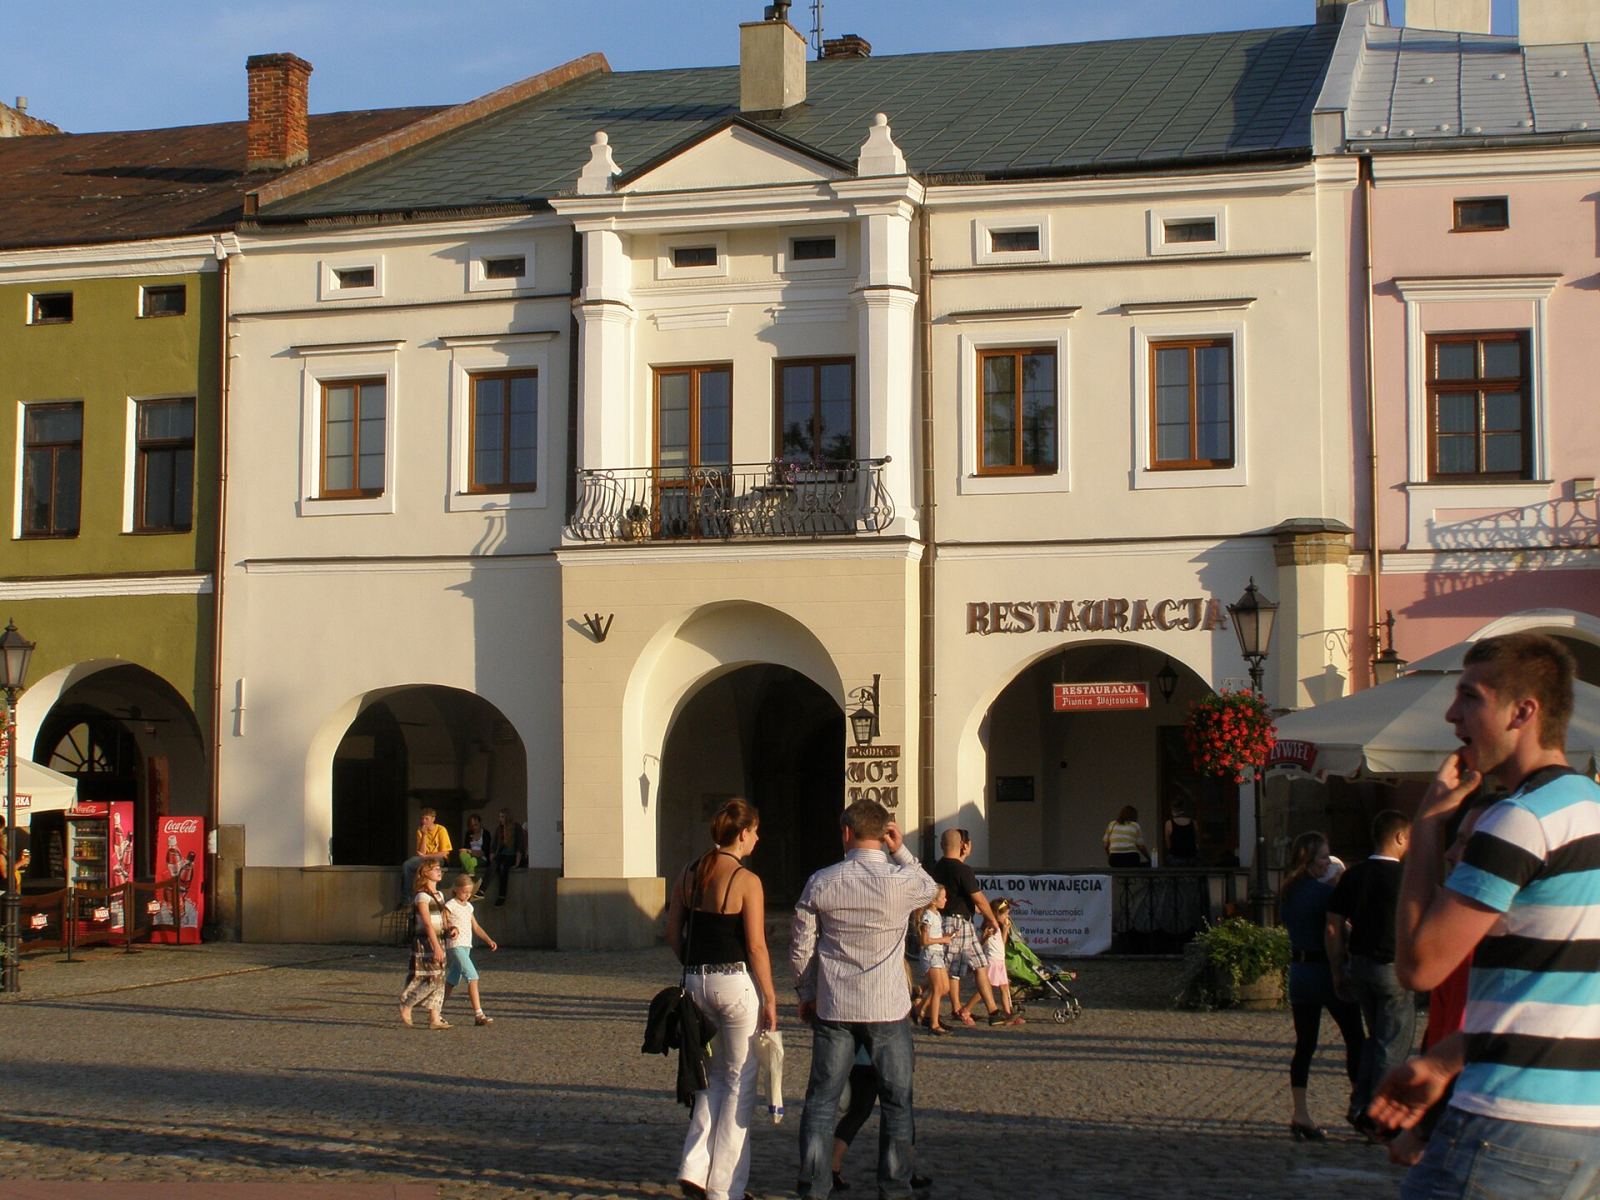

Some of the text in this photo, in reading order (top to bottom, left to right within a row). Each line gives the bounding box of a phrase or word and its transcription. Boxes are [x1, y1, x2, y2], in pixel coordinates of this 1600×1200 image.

[966, 598, 1228, 635] RESTAURACJA
[1062, 685, 1138, 695] RESTAURACJA
[1062, 697, 1093, 706] Piwnica
[1008, 879, 1025, 891] DO
[1029, 879, 1103, 893] WYNAJĘCIA
